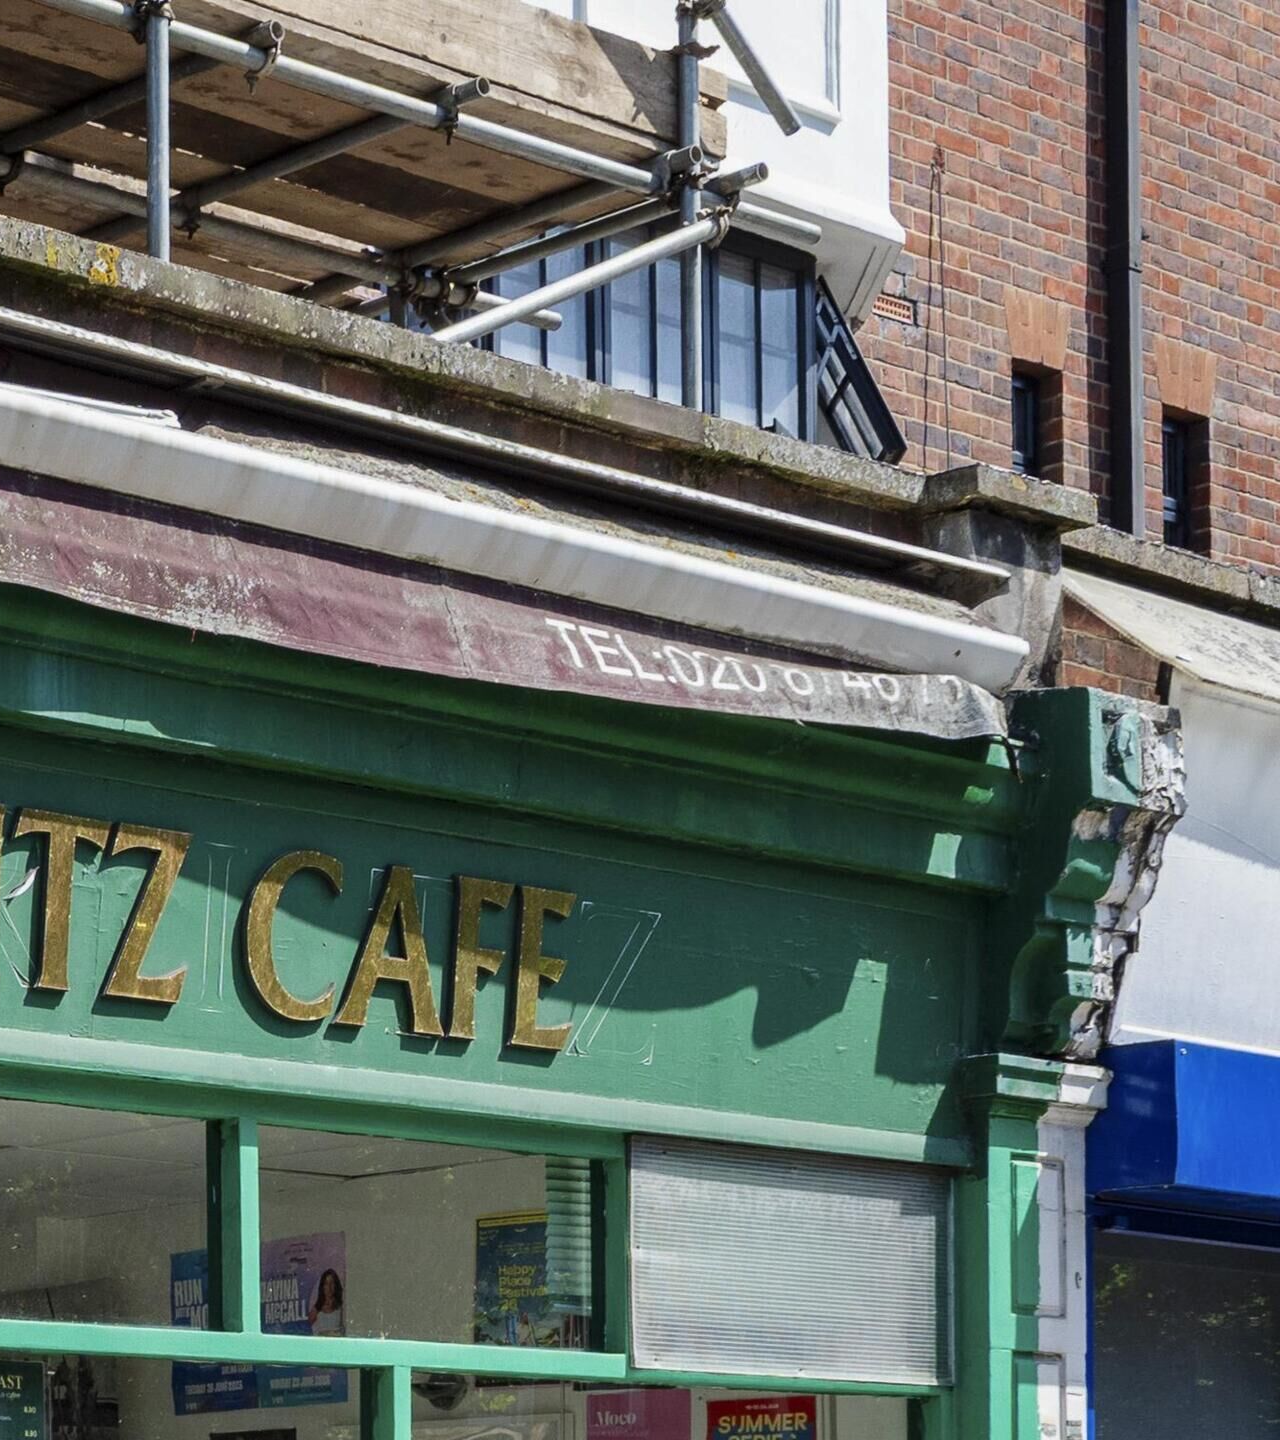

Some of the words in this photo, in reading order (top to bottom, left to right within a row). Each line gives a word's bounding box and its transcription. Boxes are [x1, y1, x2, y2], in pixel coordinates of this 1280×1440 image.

[245, 849, 577, 1051] CAFE
[174, 1279, 203, 1305] RUN
[718, 1412, 808, 1434] SUMMER
